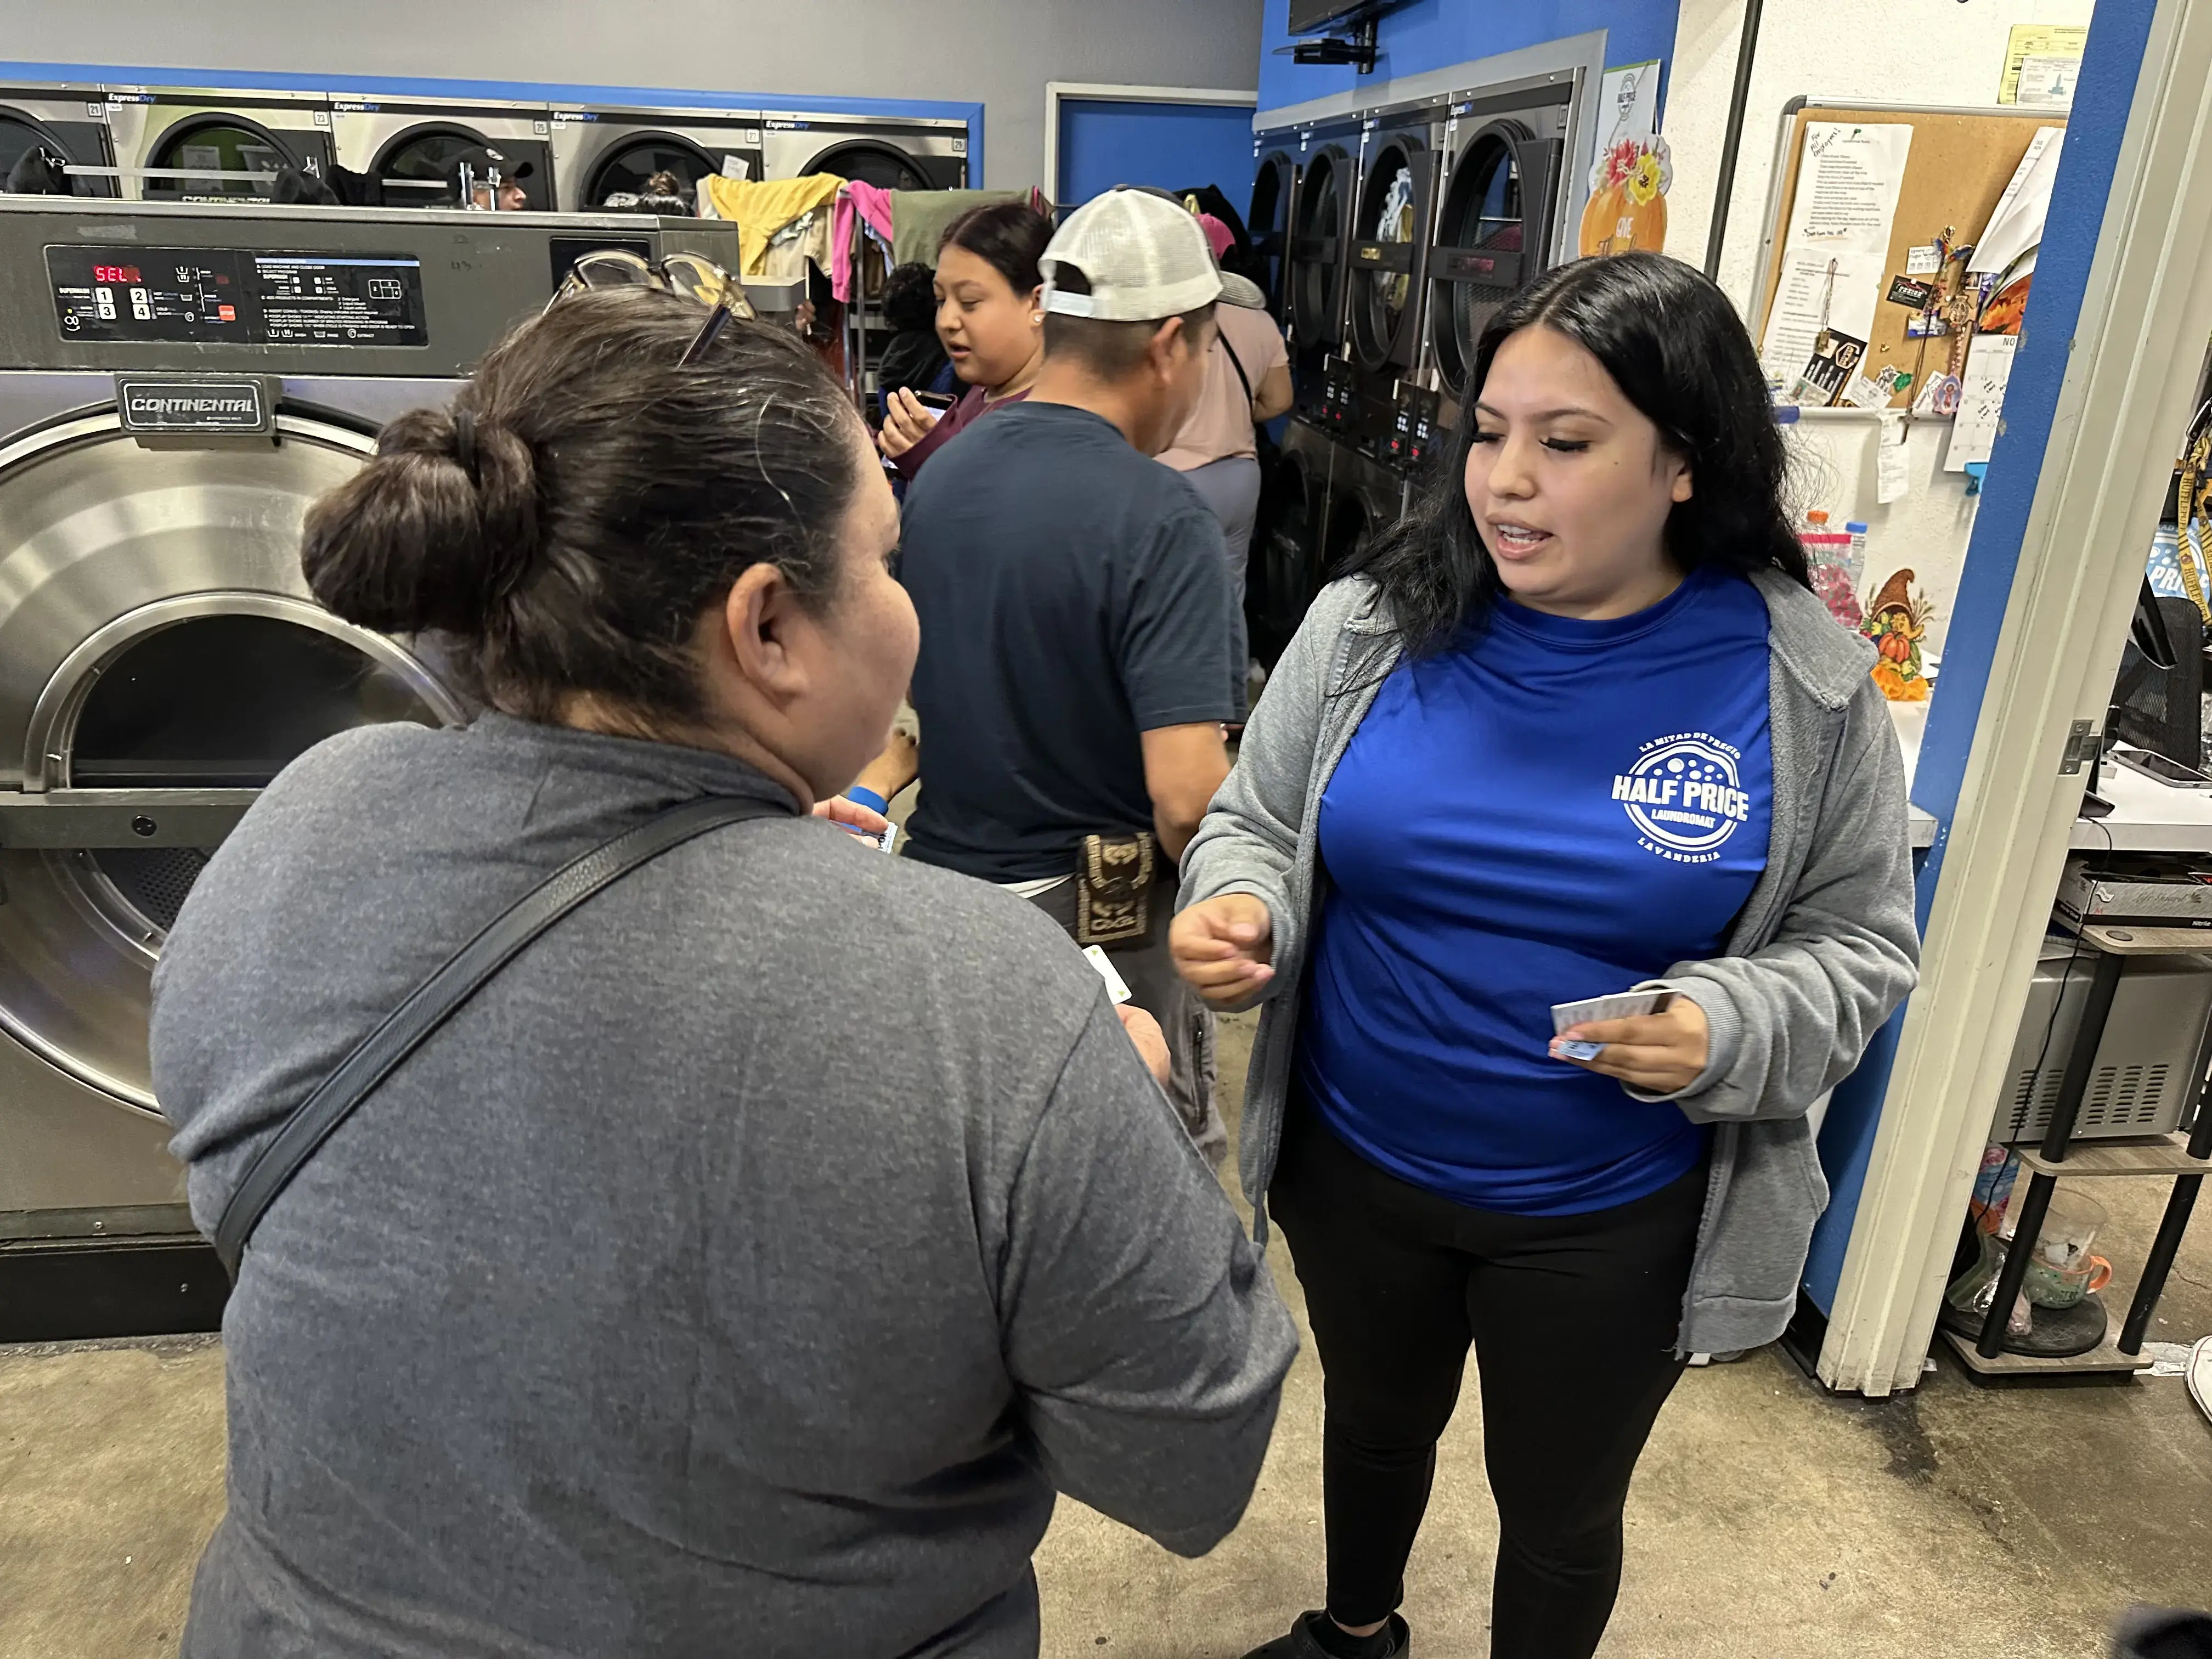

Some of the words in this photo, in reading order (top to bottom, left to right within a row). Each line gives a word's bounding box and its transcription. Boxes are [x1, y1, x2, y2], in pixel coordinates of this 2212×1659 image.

[109, 93, 155, 104] ExpressDry
[100, 291, 108, 301] 1
[135, 291, 143, 301] 2
[103, 306, 111, 316] 3
[138, 307, 145, 316] 4
[131, 398, 255, 412] CONTINENTAL
[1639, 742, 1655, 753] LA
[1655, 732, 1691, 748] MITAD
[1693, 732, 1708, 741] DE
[1708, 735, 1741, 760] PRECIO
[1611, 775, 1679, 805] HALF
[1683, 781, 1750, 822] PRICE
[1651, 808, 1716, 830] LAUNDROMAT
[1637, 837, 1720, 864] LAVANDERIA
